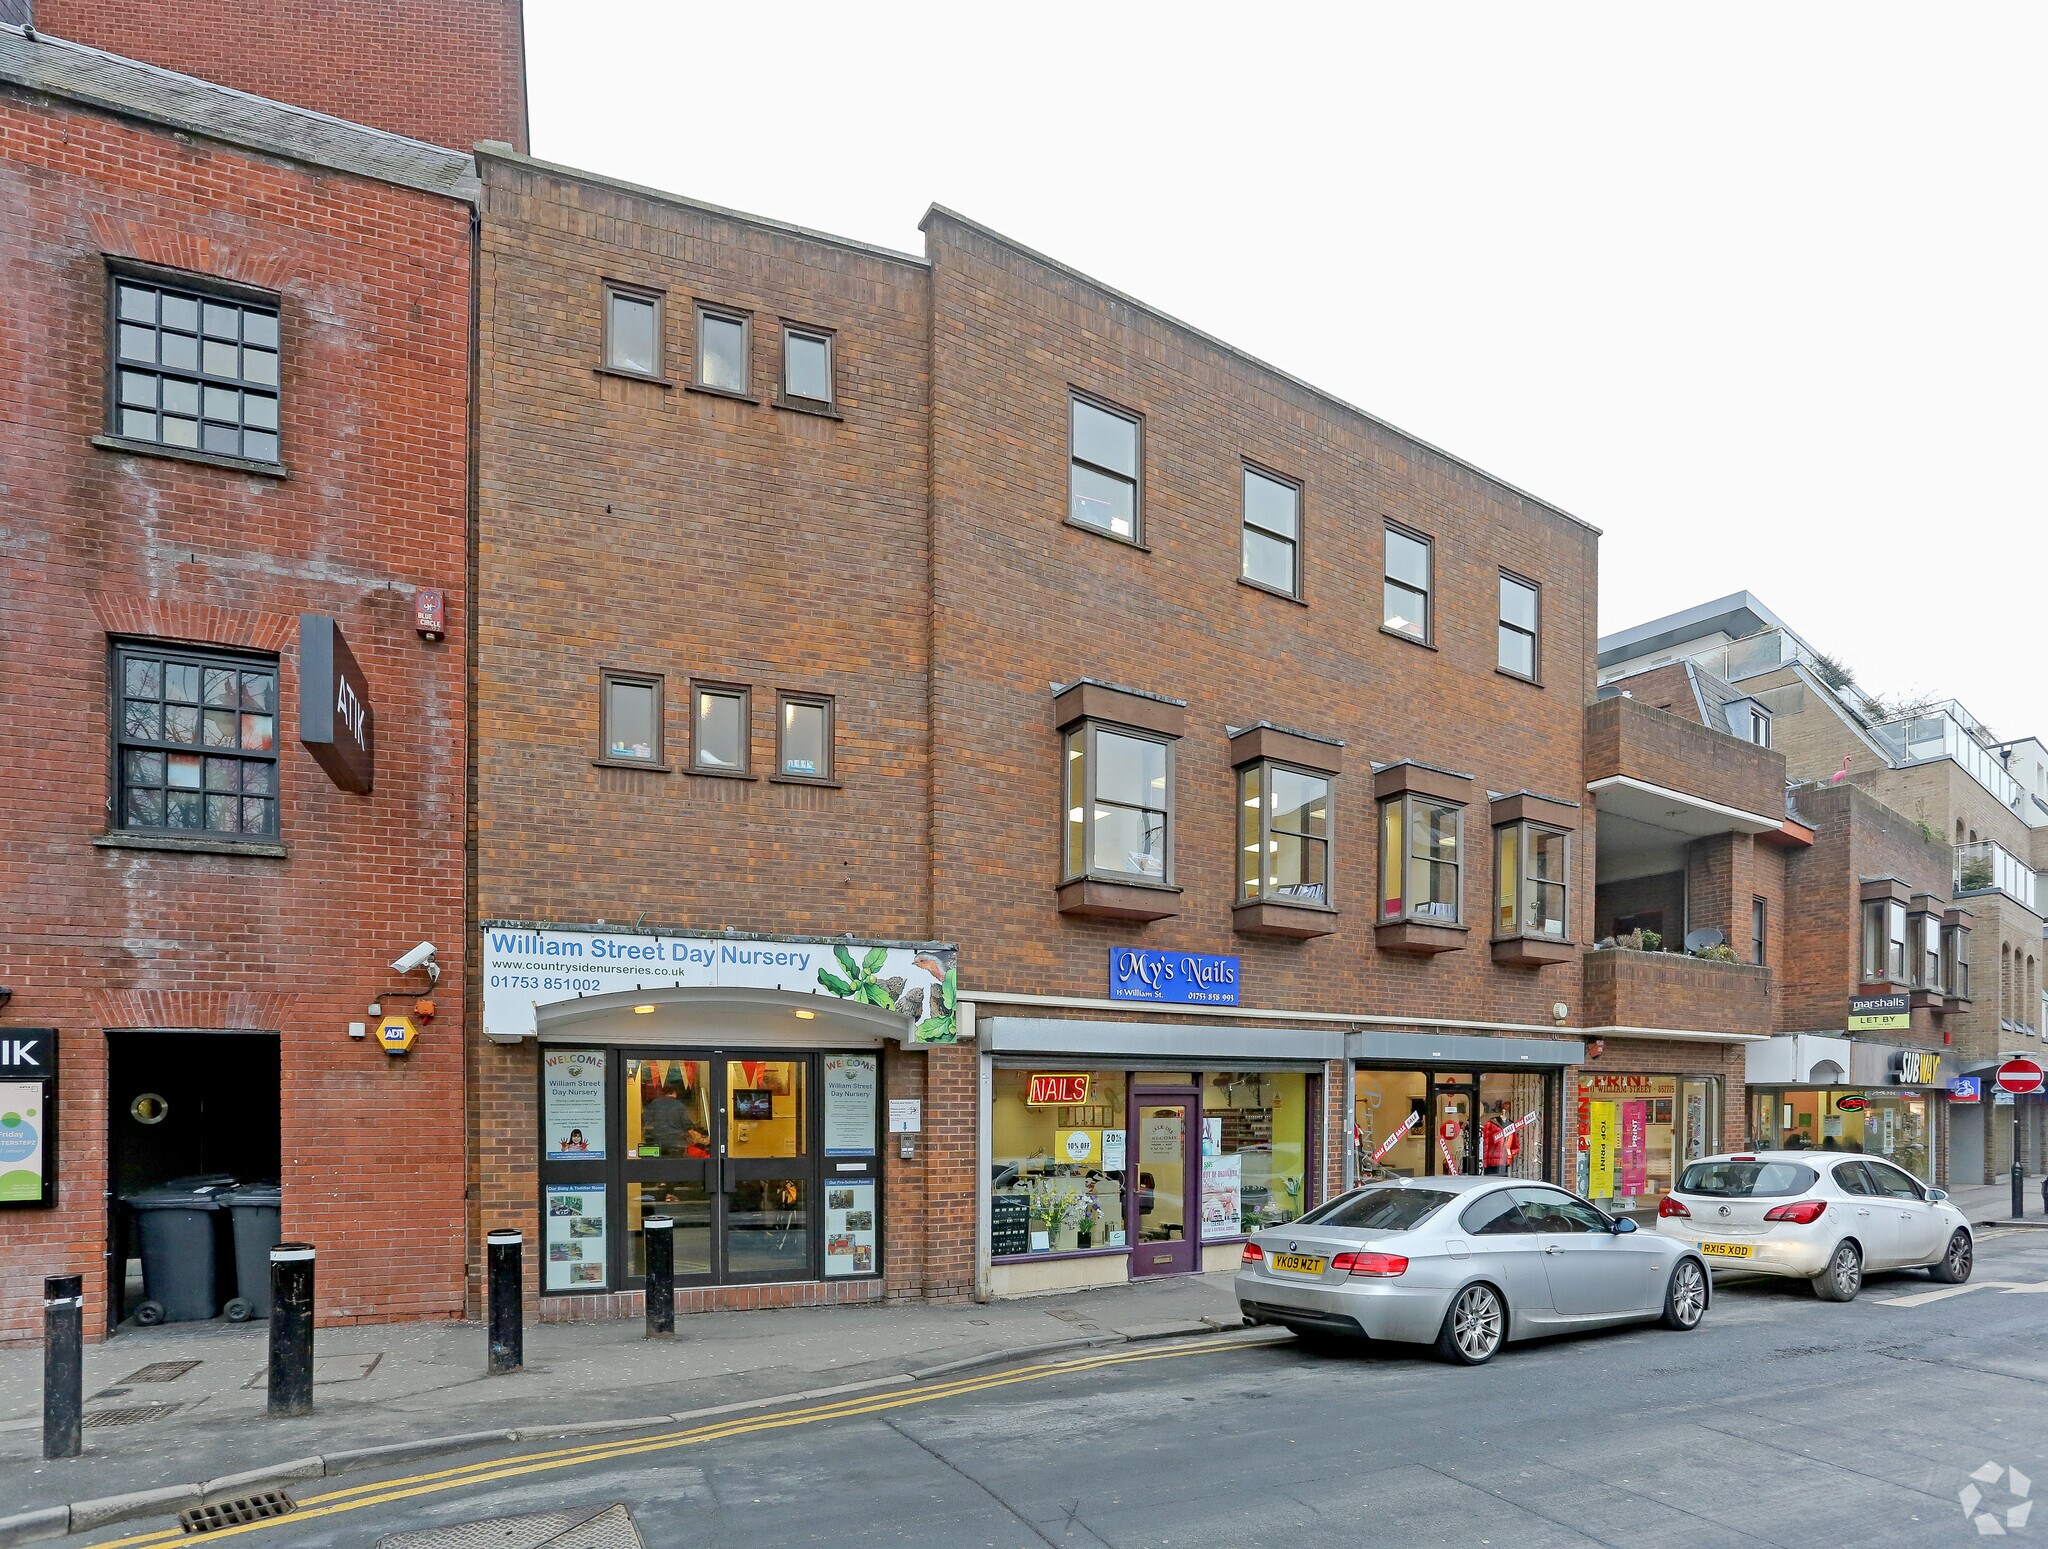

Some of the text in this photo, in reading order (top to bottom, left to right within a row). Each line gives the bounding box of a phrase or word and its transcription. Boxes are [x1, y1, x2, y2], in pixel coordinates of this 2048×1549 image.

[420, 619, 440, 627] CIRCLE
[337, 674, 365, 752] ATIK
[491, 933, 811, 971] William Street Day Nursery
[492, 961, 685, 976] www.countrysidenurseries.co.uk
[1119, 952, 1234, 989] My's Nails
[490, 976, 601, 992] 01753 851002
[1124, 989, 1152, 998] William
[1188, 992, 1206, 1000] 01753
[1853, 998, 1905, 1009] marshalls
[1860, 1016, 1878, 1024] LET
[385, 1029, 404, 1039] ADT
[2, 1040, 39, 1065] IK
[546, 1054, 603, 1068] WELCOME
[827, 1059, 875, 1072] WELCOME
[1900, 1052, 1941, 1084] SUBWAY
[1032, 1078, 1085, 1102] NAILS
[1840, 1100, 1869, 1108] OPEN
[1106, 1134, 1122, 1142] 20%
[1375, 1113, 1417, 1159] SALE SALE SALE SALE
[1440, 1138, 1458, 1176] CLEARANC
[1704, 1244, 1748, 1256] RX15 XOD
[1277, 1255, 1320, 1271] YK09 MZT
